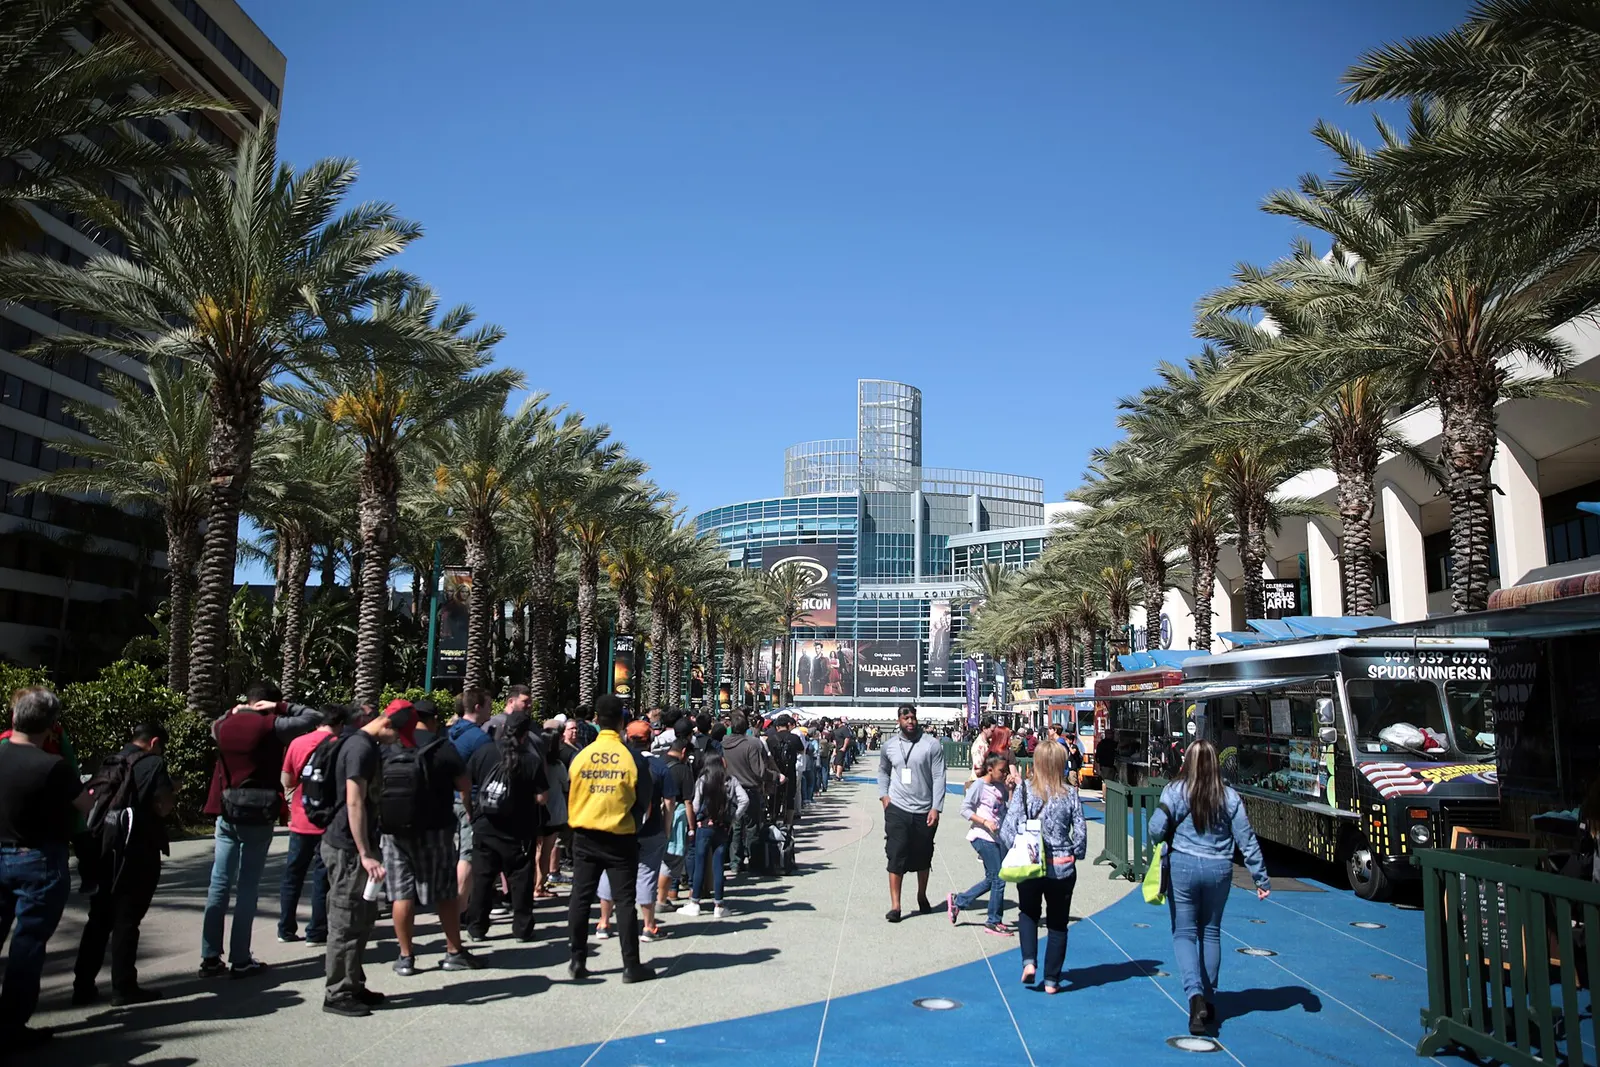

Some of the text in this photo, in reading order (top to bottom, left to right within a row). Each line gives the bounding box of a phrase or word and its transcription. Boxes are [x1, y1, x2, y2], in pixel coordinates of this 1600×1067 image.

[924, 590, 969, 598] CONVEN
[1267, 598, 1295, 610] ARTS
[859, 664, 917, 673] MIDNIGHT,
[1368, 664, 1491, 680] SPUDRUNNERS.N
[1490, 656, 1537, 680] Swarm
[591, 752, 620, 764] CSC
[581, 770, 627, 779] SECURITY
[590, 784, 616, 794] STAFF
